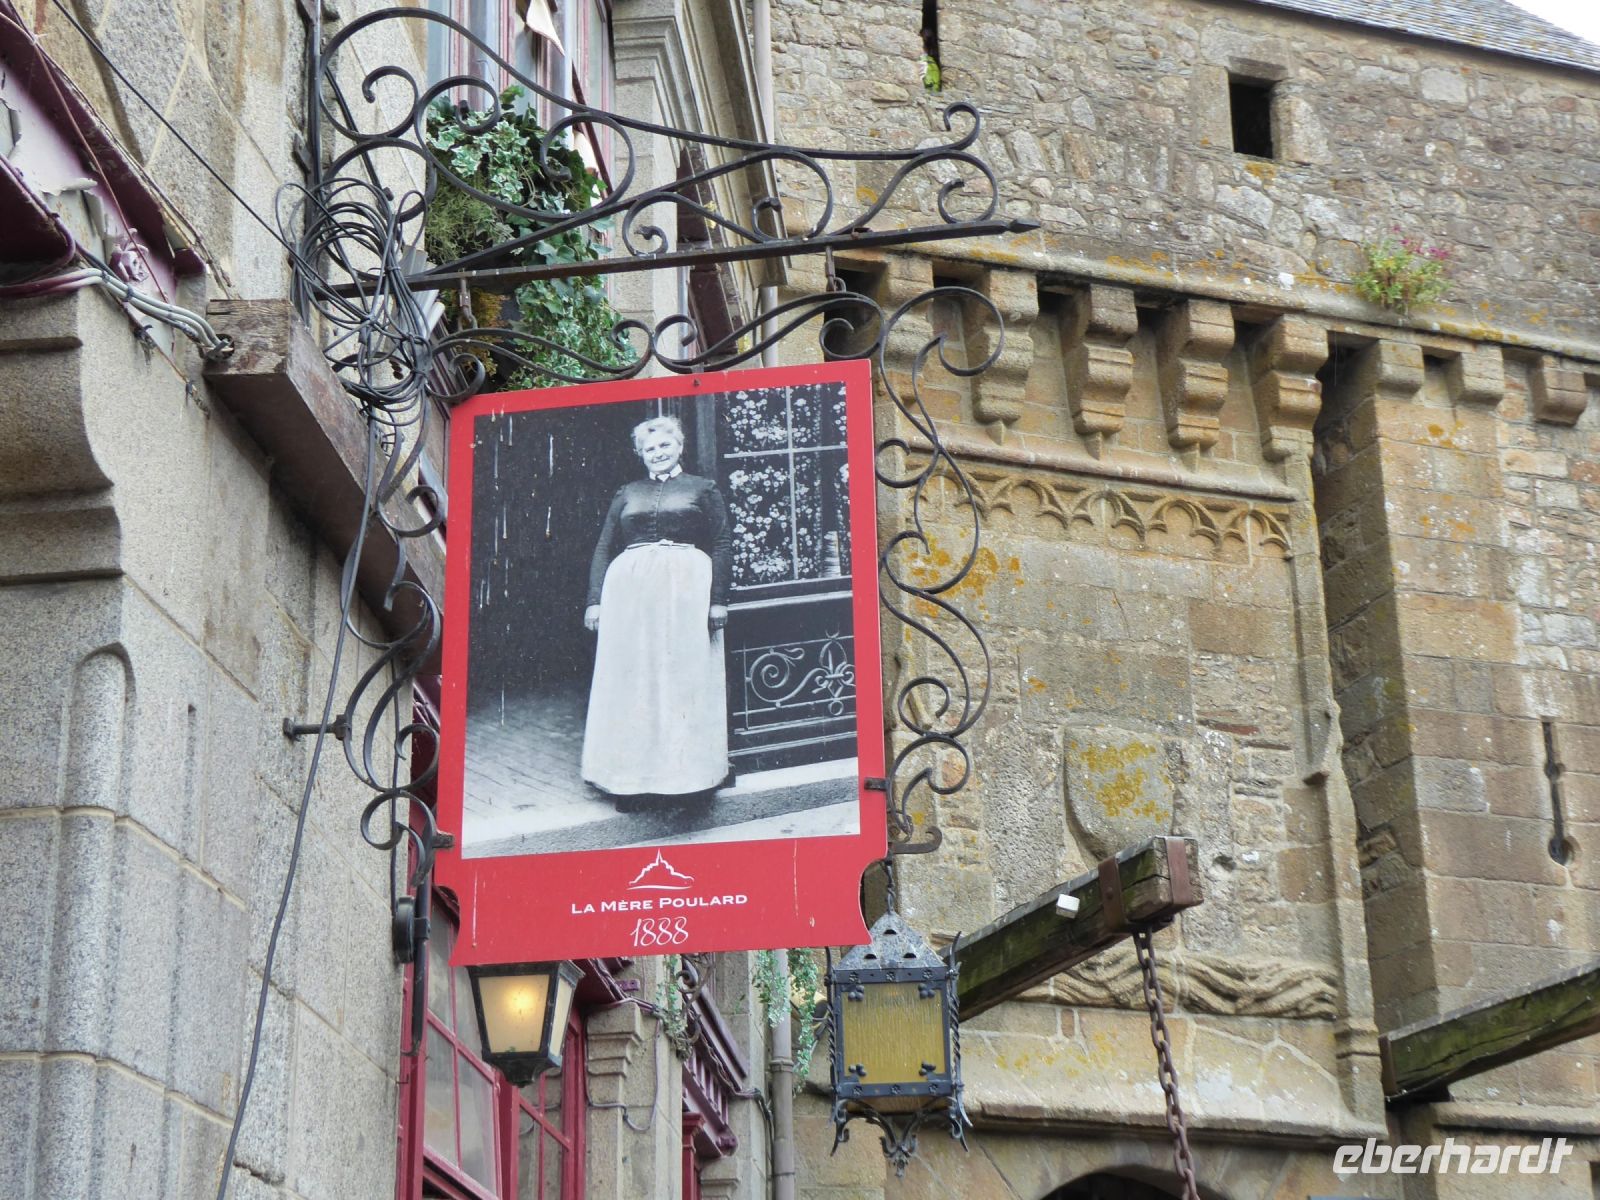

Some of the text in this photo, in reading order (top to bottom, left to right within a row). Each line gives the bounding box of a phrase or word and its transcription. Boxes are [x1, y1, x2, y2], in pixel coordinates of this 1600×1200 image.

[571, 903, 595, 914] LA
[659, 894, 748, 909] POULARD
[630, 916, 689, 947] 1888
